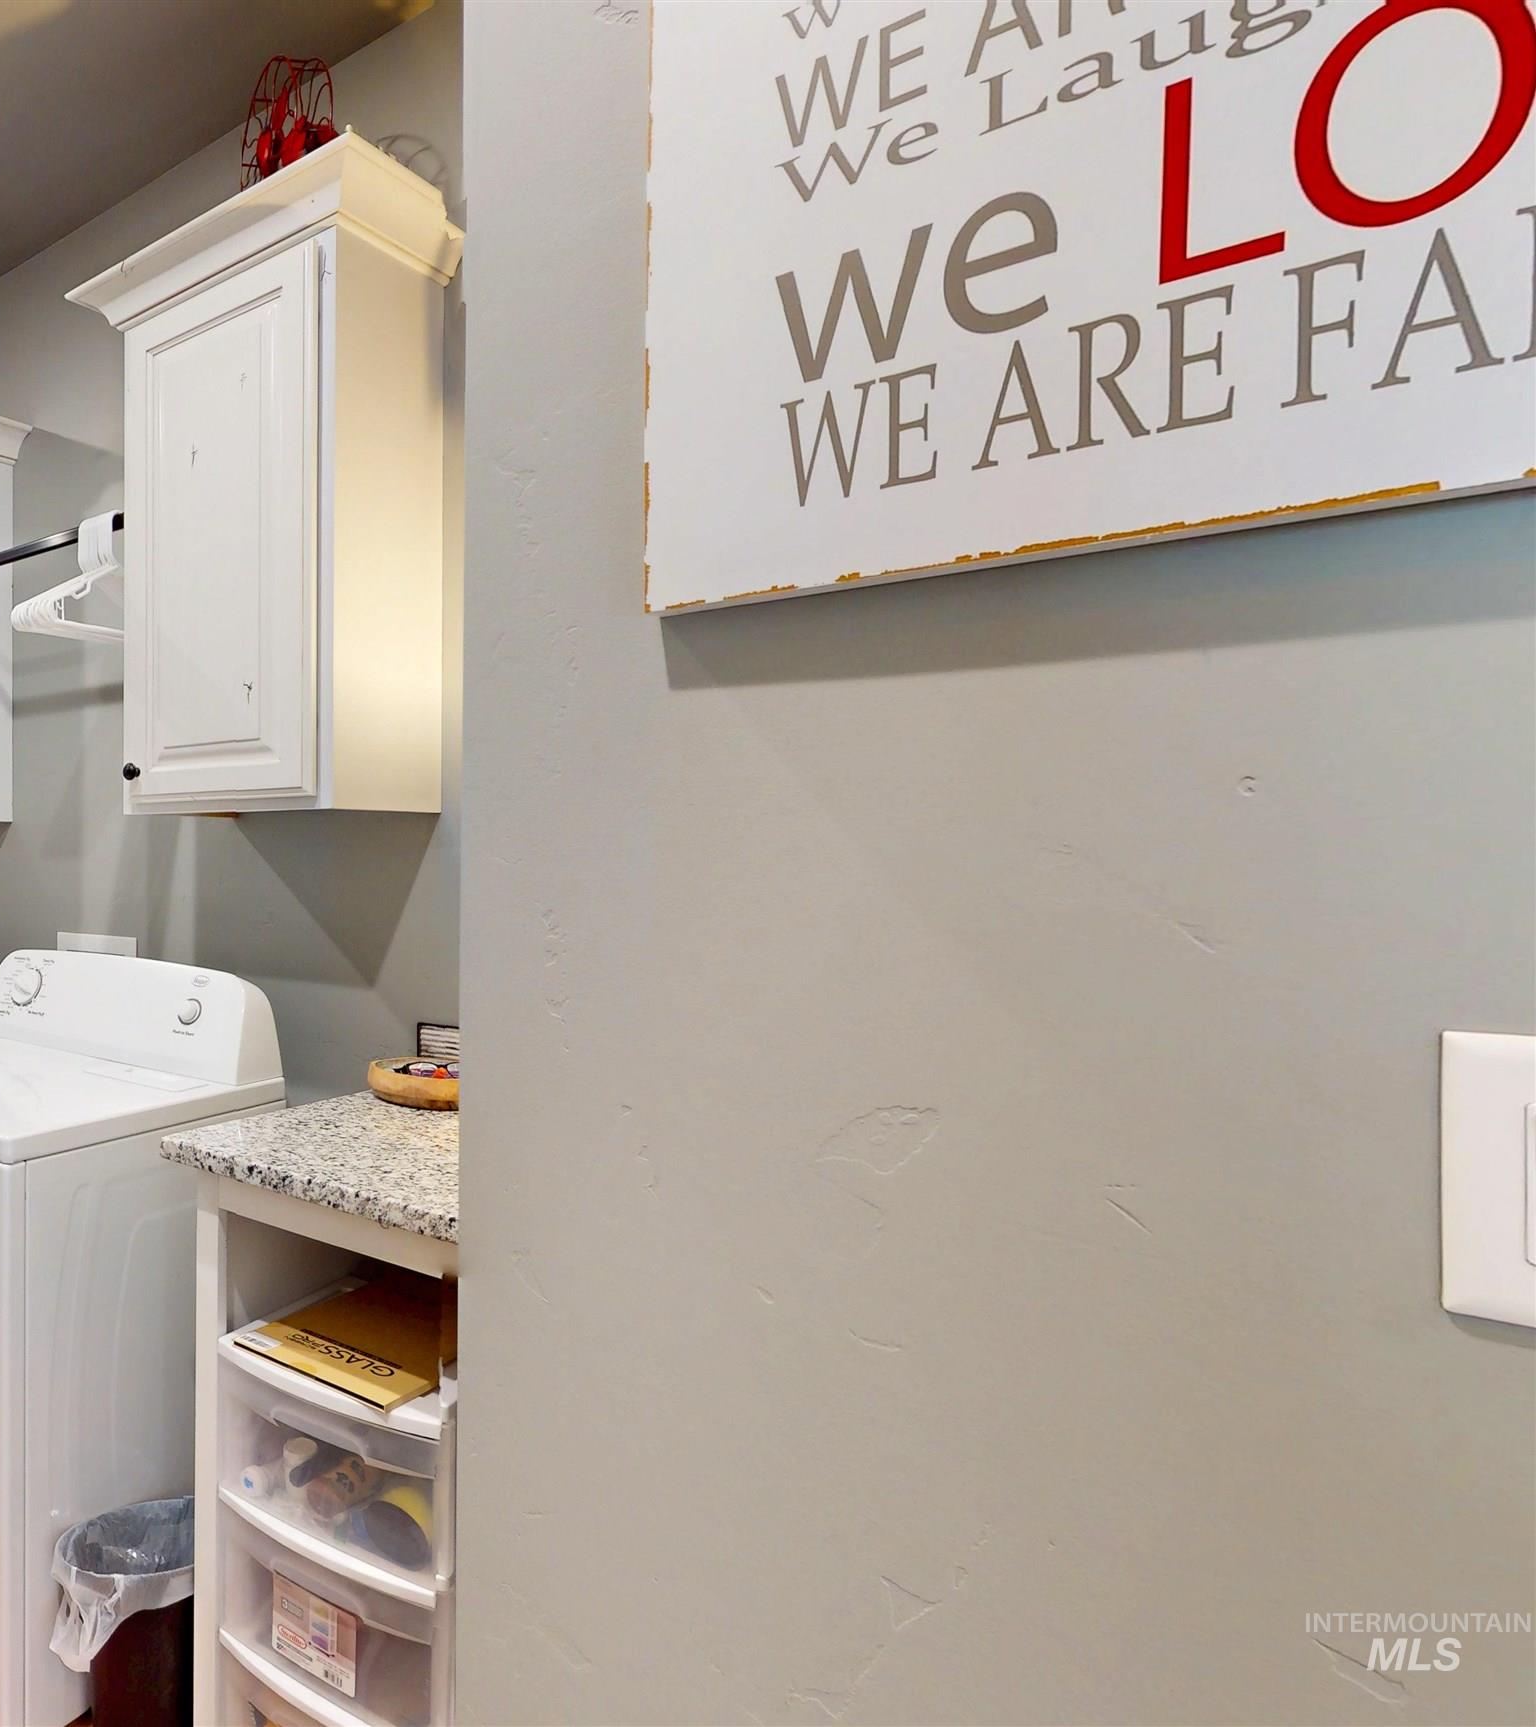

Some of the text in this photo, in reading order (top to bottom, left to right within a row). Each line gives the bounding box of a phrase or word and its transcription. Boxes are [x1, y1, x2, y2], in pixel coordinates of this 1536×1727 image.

[774, 0, 1127, 149] WE A
[774, 0, 1327, 204] We Laug
[774, 191, 1060, 385] we
[779, 204, 1536, 508] WE ARE FA
